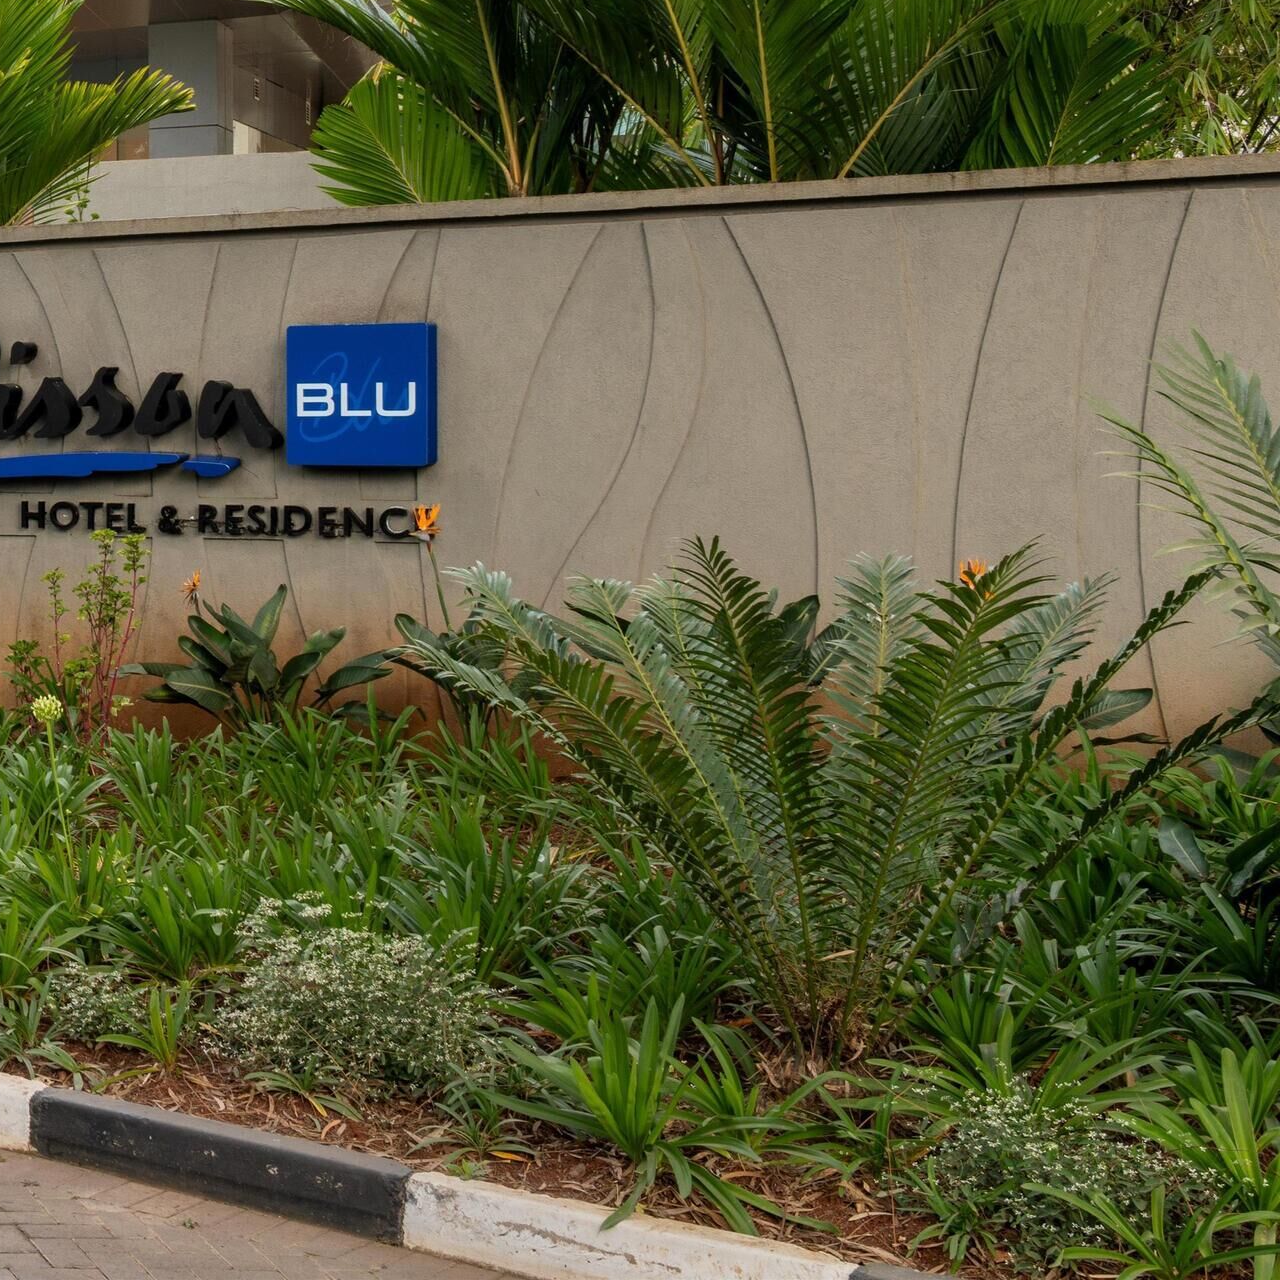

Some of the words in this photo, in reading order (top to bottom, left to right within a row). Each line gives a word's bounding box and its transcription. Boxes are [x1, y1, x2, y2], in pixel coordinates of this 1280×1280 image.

[296, 381, 417, 417] BLU
[21, 500, 147, 534] HOTEL
[158, 505, 184, 535] &
